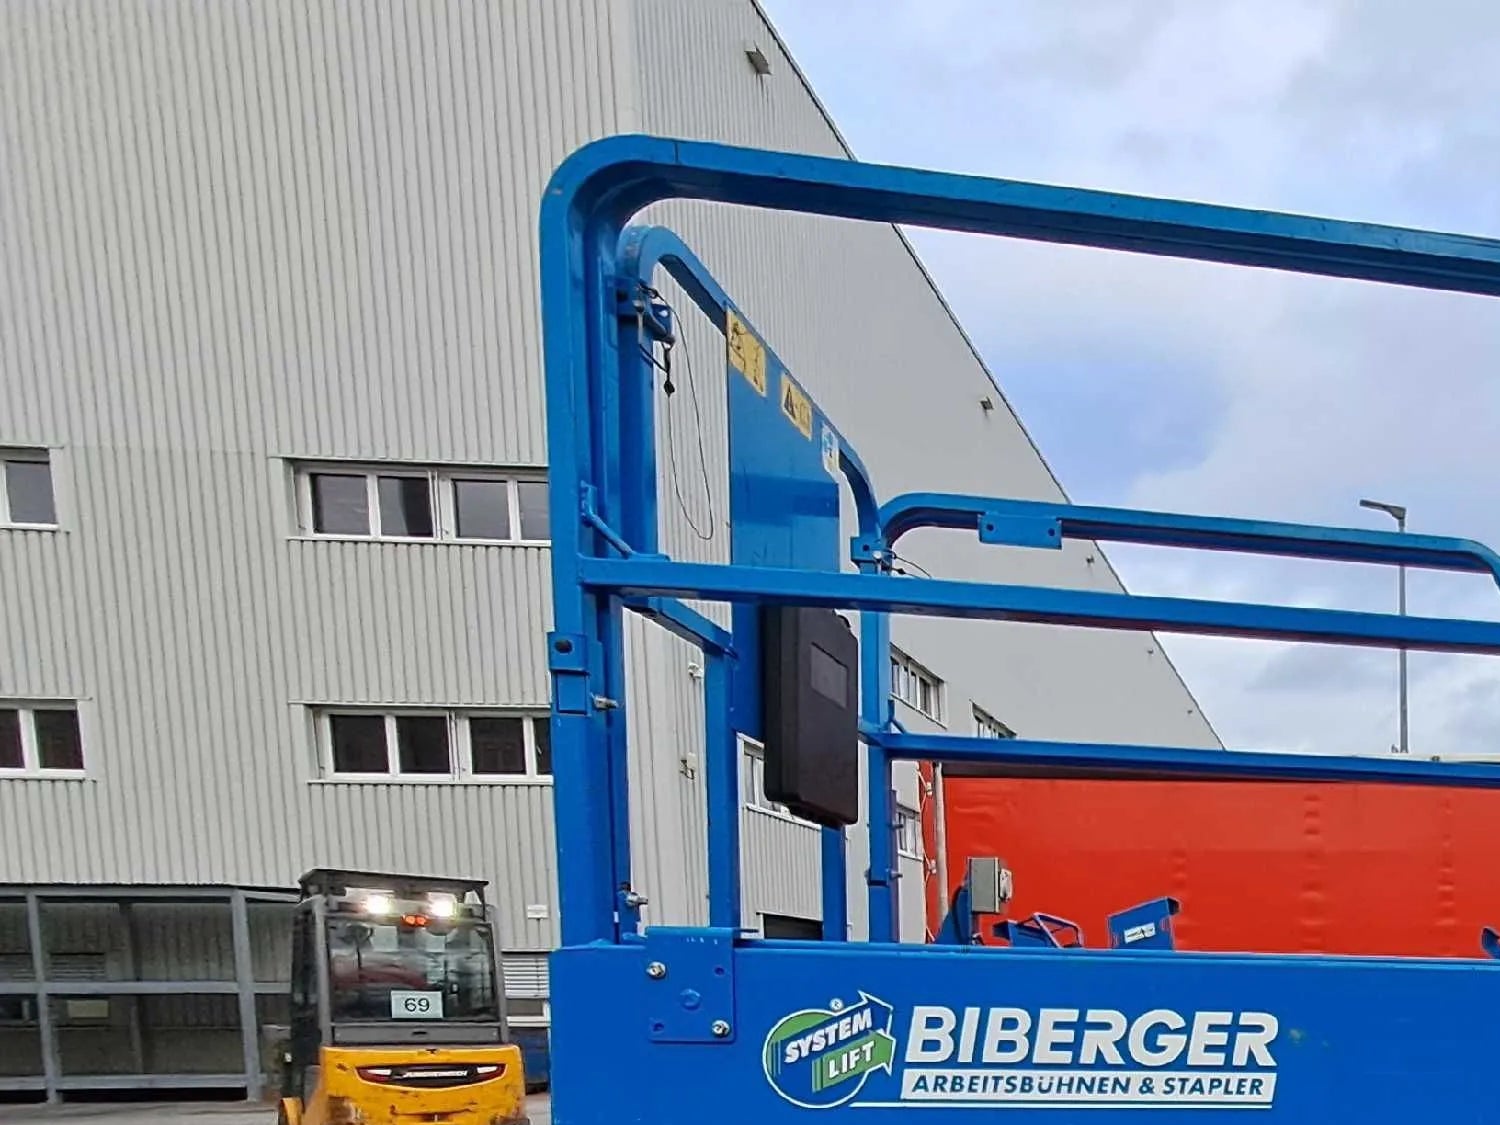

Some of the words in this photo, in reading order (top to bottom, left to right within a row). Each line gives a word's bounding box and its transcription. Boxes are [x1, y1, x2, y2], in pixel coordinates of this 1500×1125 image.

[404, 997, 430, 1012] 69
[784, 1007, 873, 1063] SYSTEM
[905, 1005, 1279, 1067] BIBERGER
[828, 1040, 875, 1078] LIFT
[911, 1074, 1130, 1096] ARBEITSBÜHNEN
[1137, 1077, 1155, 1095] &
[1161, 1077, 1265, 1097] STAPLER
